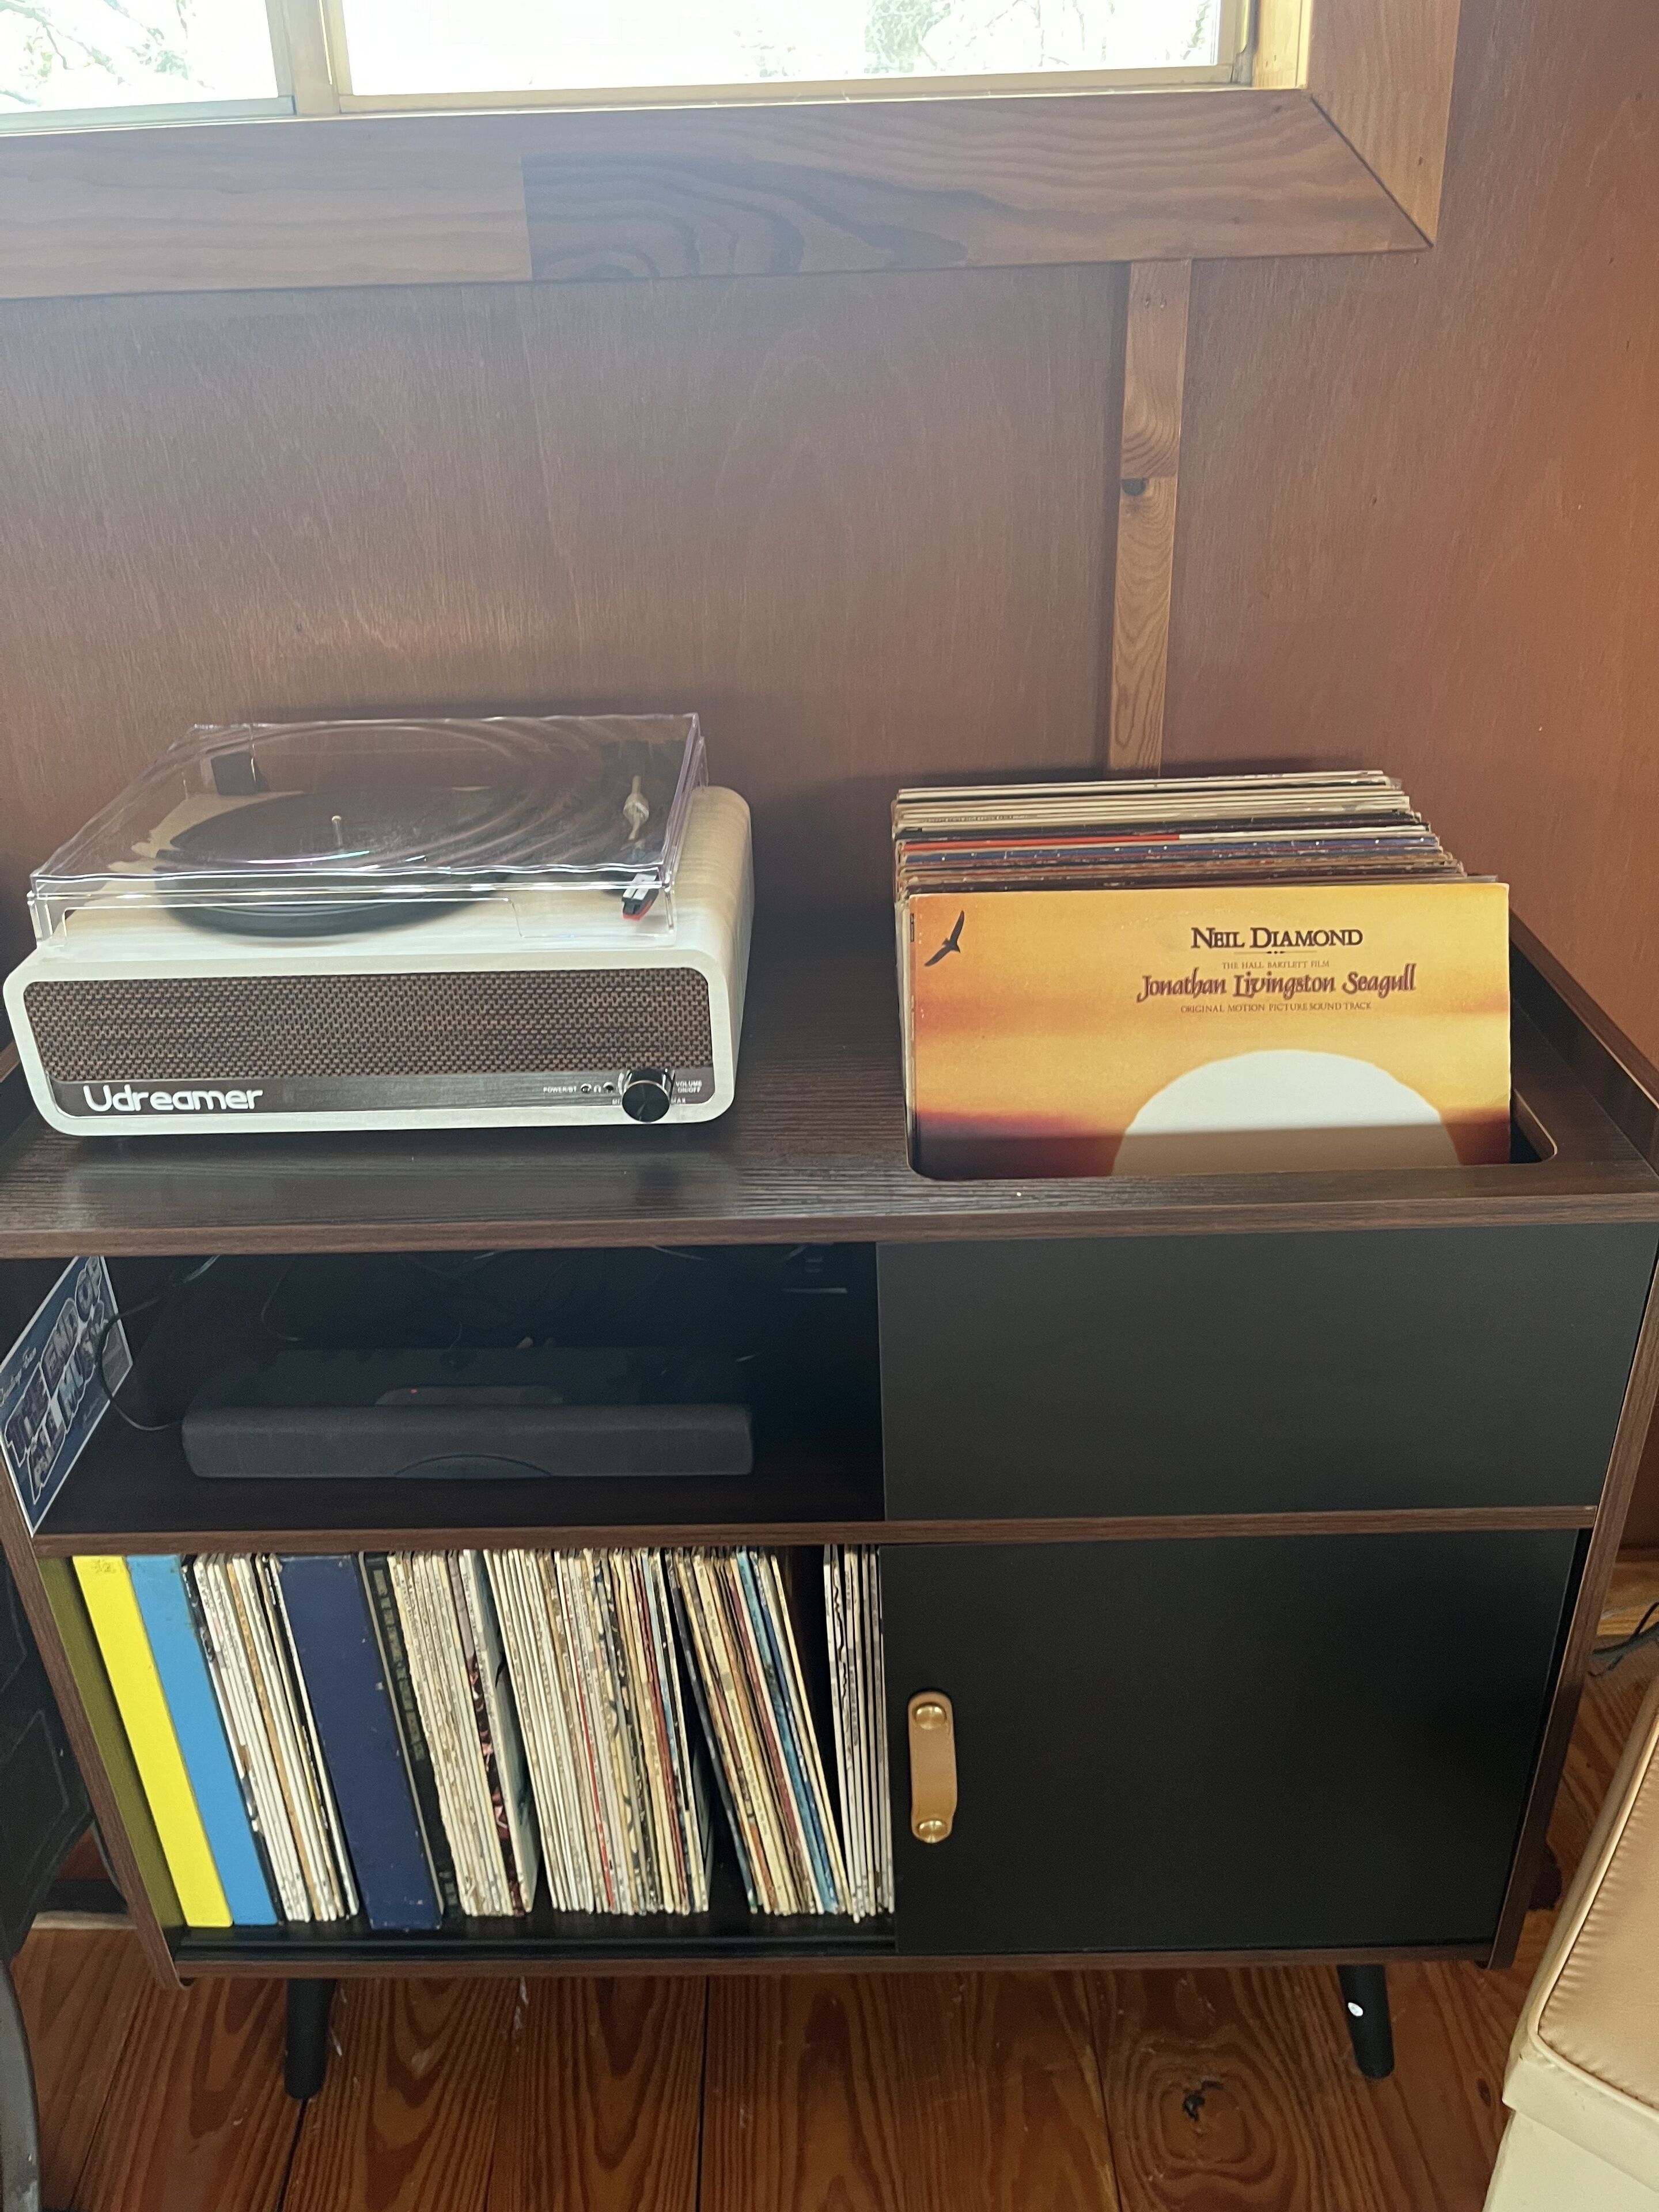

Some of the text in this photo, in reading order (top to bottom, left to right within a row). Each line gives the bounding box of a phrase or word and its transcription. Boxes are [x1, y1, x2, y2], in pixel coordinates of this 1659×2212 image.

[1190, 927, 1363, 949] NEIL DIAMOND
[1222, 961, 1238, 969] THE
[1267, 961, 1308, 969] BARTLETT
[1310, 960, 1330, 968] FILM
[1136, 963, 1417, 1003] Jonathan Livingston Seagull
[1180, 1002, 1372, 1013] ORIGINAL MOTION PICTURE SOUND TRACK
[83, 1084, 263, 1112] Udreamer
